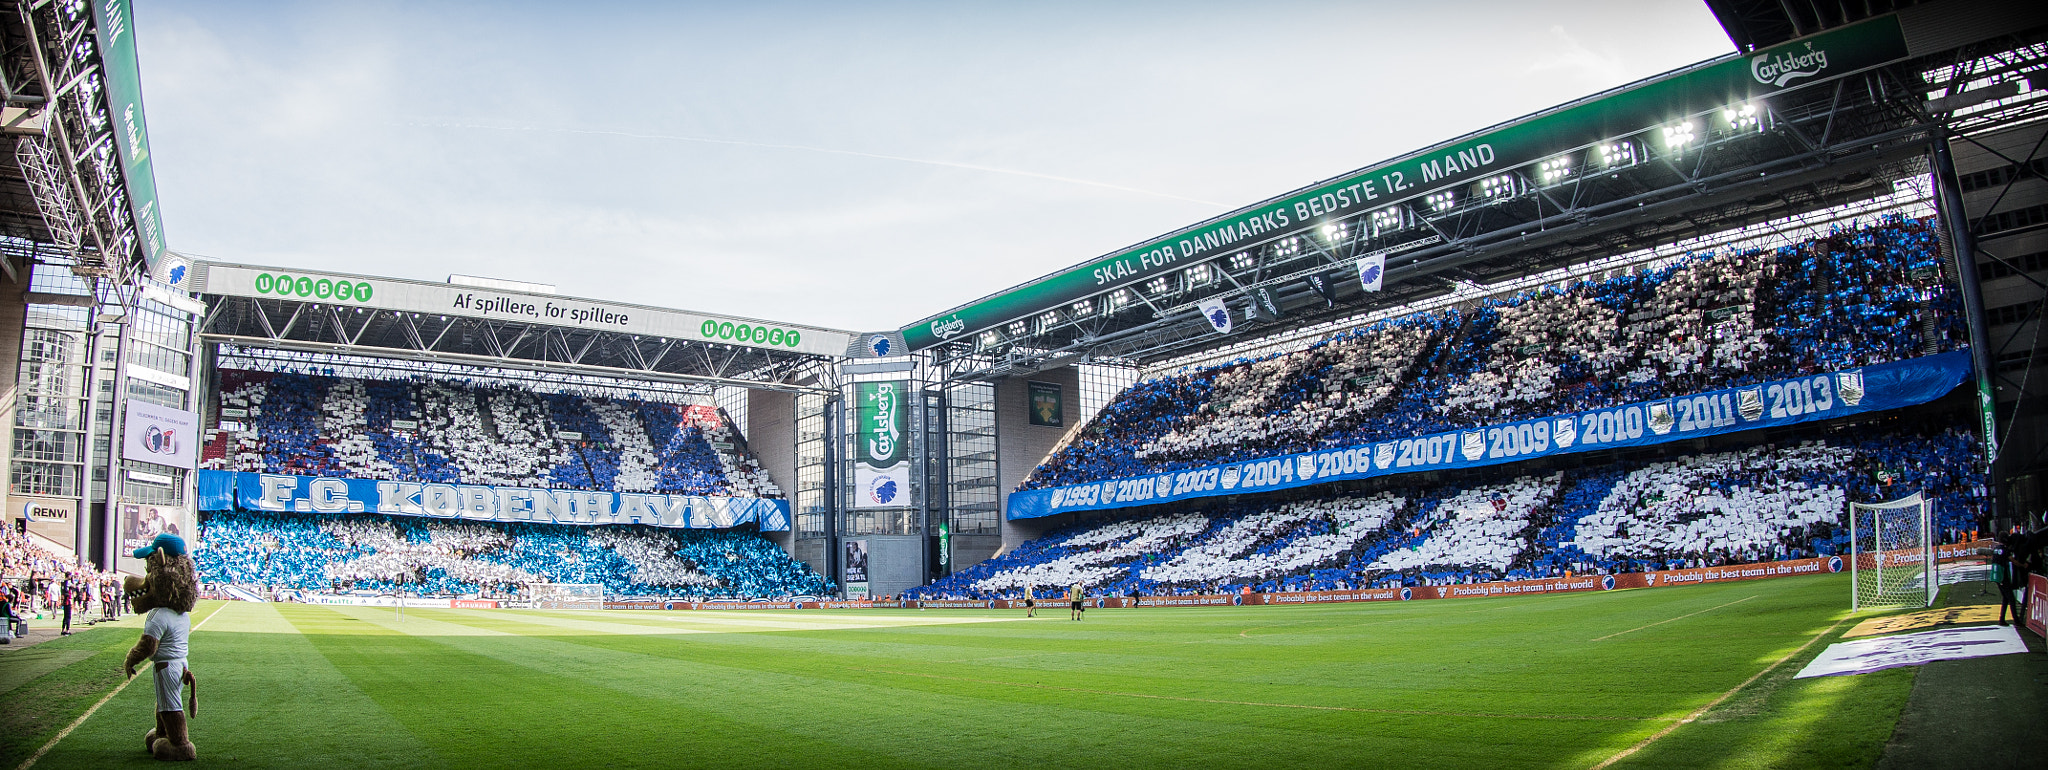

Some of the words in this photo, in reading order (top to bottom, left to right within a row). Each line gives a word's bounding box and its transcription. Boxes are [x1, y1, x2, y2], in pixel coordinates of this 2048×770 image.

[1751, 49, 1828, 87] Carlsberg
[1093, 259, 1138, 286] SKÅL
[1140, 245, 1177, 271] FOR
[1179, 208, 1290, 257] DANMARKS
[1294, 180, 1378, 222] BEDSTE
[1382, 171, 1414, 194] 12.
[1421, 143, 1495, 184] MAND
[257, 275, 372, 301] UNIBET
[453, 293, 473, 309] Af
[475, 296, 539, 318] spillere,
[544, 302, 567, 319] for
[570, 307, 629, 326] spillere
[703, 321, 799, 347] UNIBET
[931, 318, 965, 339] Carlsberg
[869, 383, 900, 460] Carlsberg
[1062, 484, 1101, 507] 1993
[1115, 477, 1156, 502] 2001
[1173, 467, 1220, 495] 2003
[1241, 458, 1294, 488] 2004
[1317, 446, 1370, 478] 2006
[1396, 433, 1458, 468] 2007
[1487, 420, 1550, 458] 2009
[1581, 405, 1644, 444] 2010
[1676, 393, 1736, 432] 2011
[1767, 375, 1833, 419] 2013
[33, 507, 68, 519] RENVI
[259, 473, 365, 513] F.C.
[377, 480, 734, 529] KØBENHAVN
[124, 538, 145, 547] MERE
[1938, 550, 1952, 559] the
[1663, 570, 1703, 584] Probably
[1705, 569, 1719, 580] the
[1721, 567, 1740, 578] best
[1742, 568, 1765, 577] team
[1767, 565, 1776, 574] in
[1777, 564, 1792, 574] the
[1794, 561, 1820, 573] world
[1276, 594, 1305, 604] Probably
[1306, 593, 1317, 602] the
[1318, 593, 1332, 602] best
[1333, 593, 1351, 601] team
[1352, 592, 1359, 600] in
[1360, 592, 1372, 600] the
[1373, 591, 1394, 600] world
[1453, 586, 1489, 597] Probably
[1490, 585, 1503, 594] the
[1504, 584, 1521, 593] best
[1522, 584, 1544, 592] team
[1545, 583, 1553, 591] in
[1554, 581, 1568, 590] the
[1570, 579, 1594, 590] world
[1156, 598, 1165, 606] the
[1200, 597, 1209, 605] the
